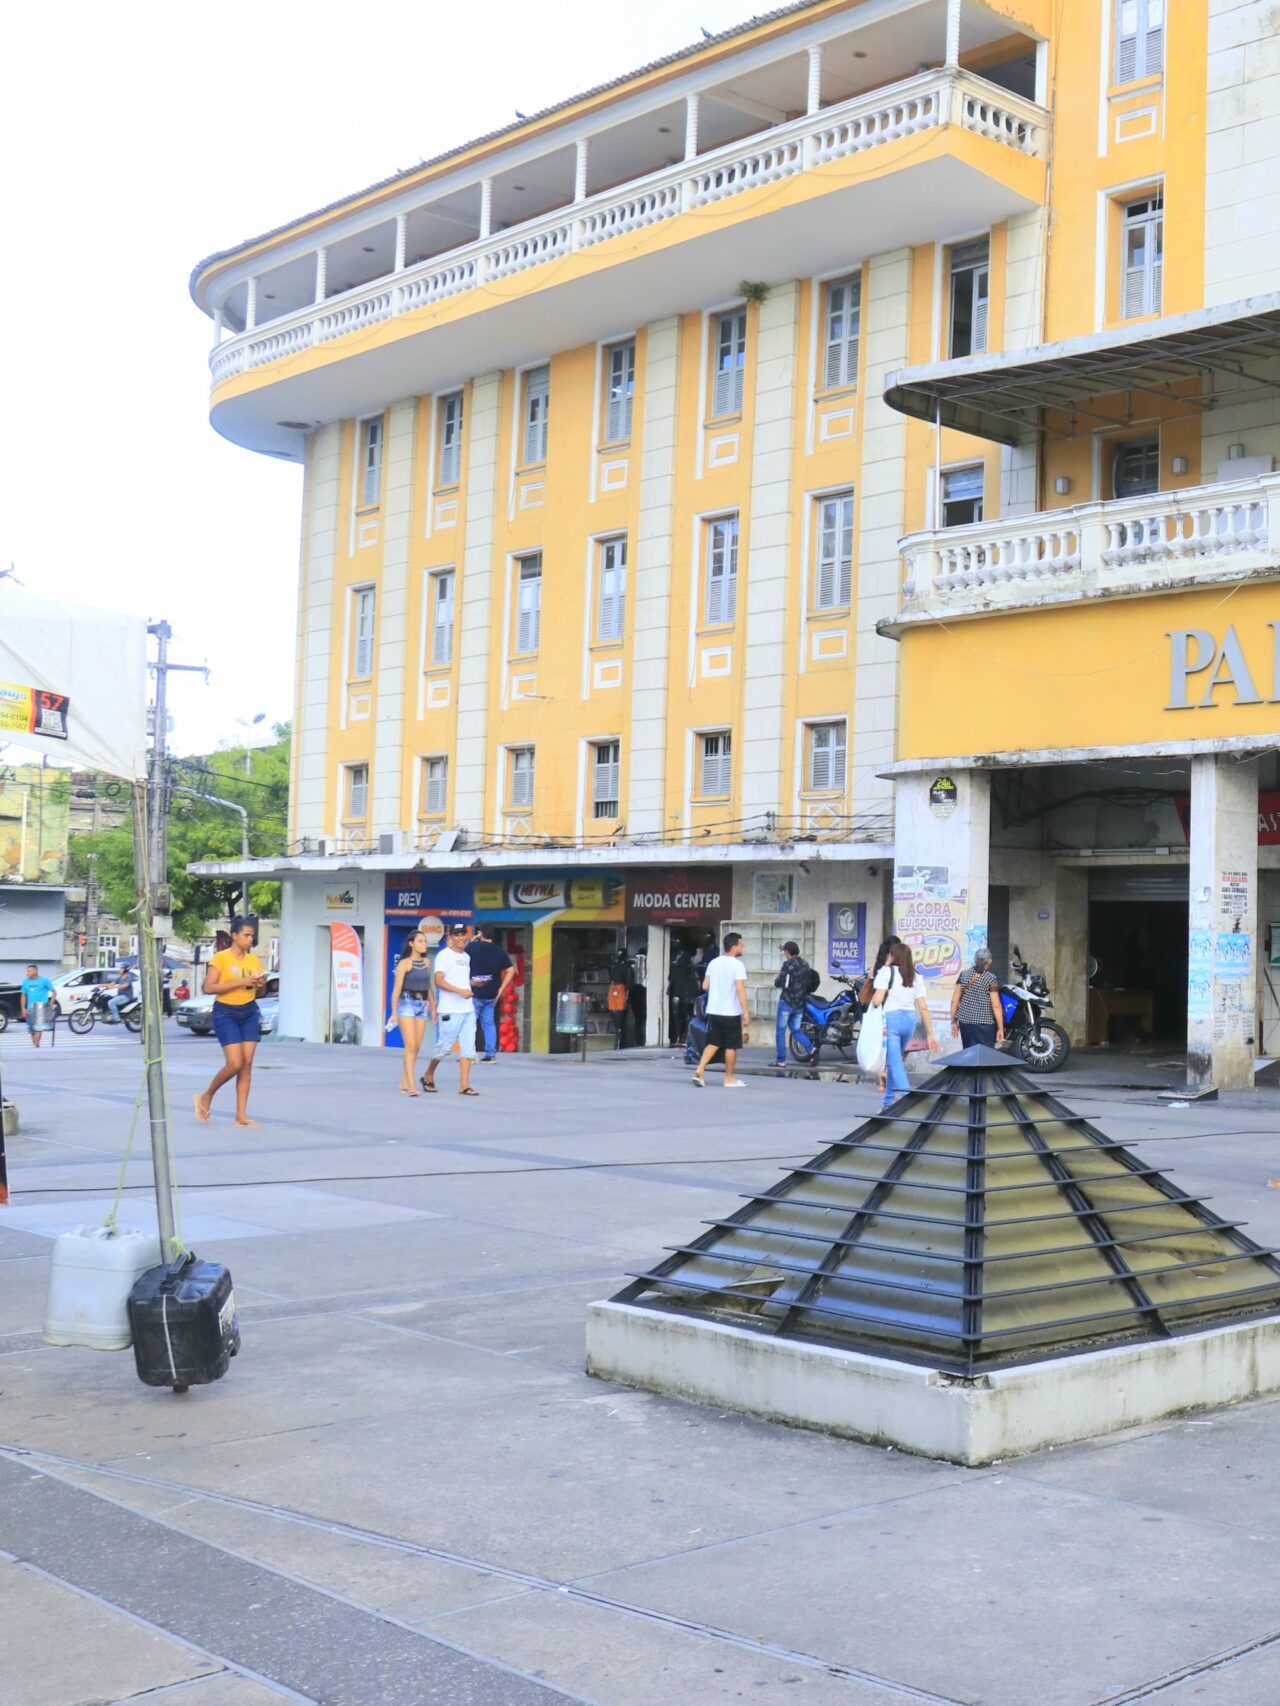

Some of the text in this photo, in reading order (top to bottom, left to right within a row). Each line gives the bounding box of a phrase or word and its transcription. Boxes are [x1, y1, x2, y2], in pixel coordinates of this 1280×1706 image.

[41, 692, 64, 711] 57
[398, 892, 422, 907] PREV
[633, 893, 720, 908] MODA CENTER
[907, 902, 952, 915] AGORA
[900, 917, 911, 929] EU
[913, 917, 933, 929] SOU
[912, 943, 955, 967] POP
